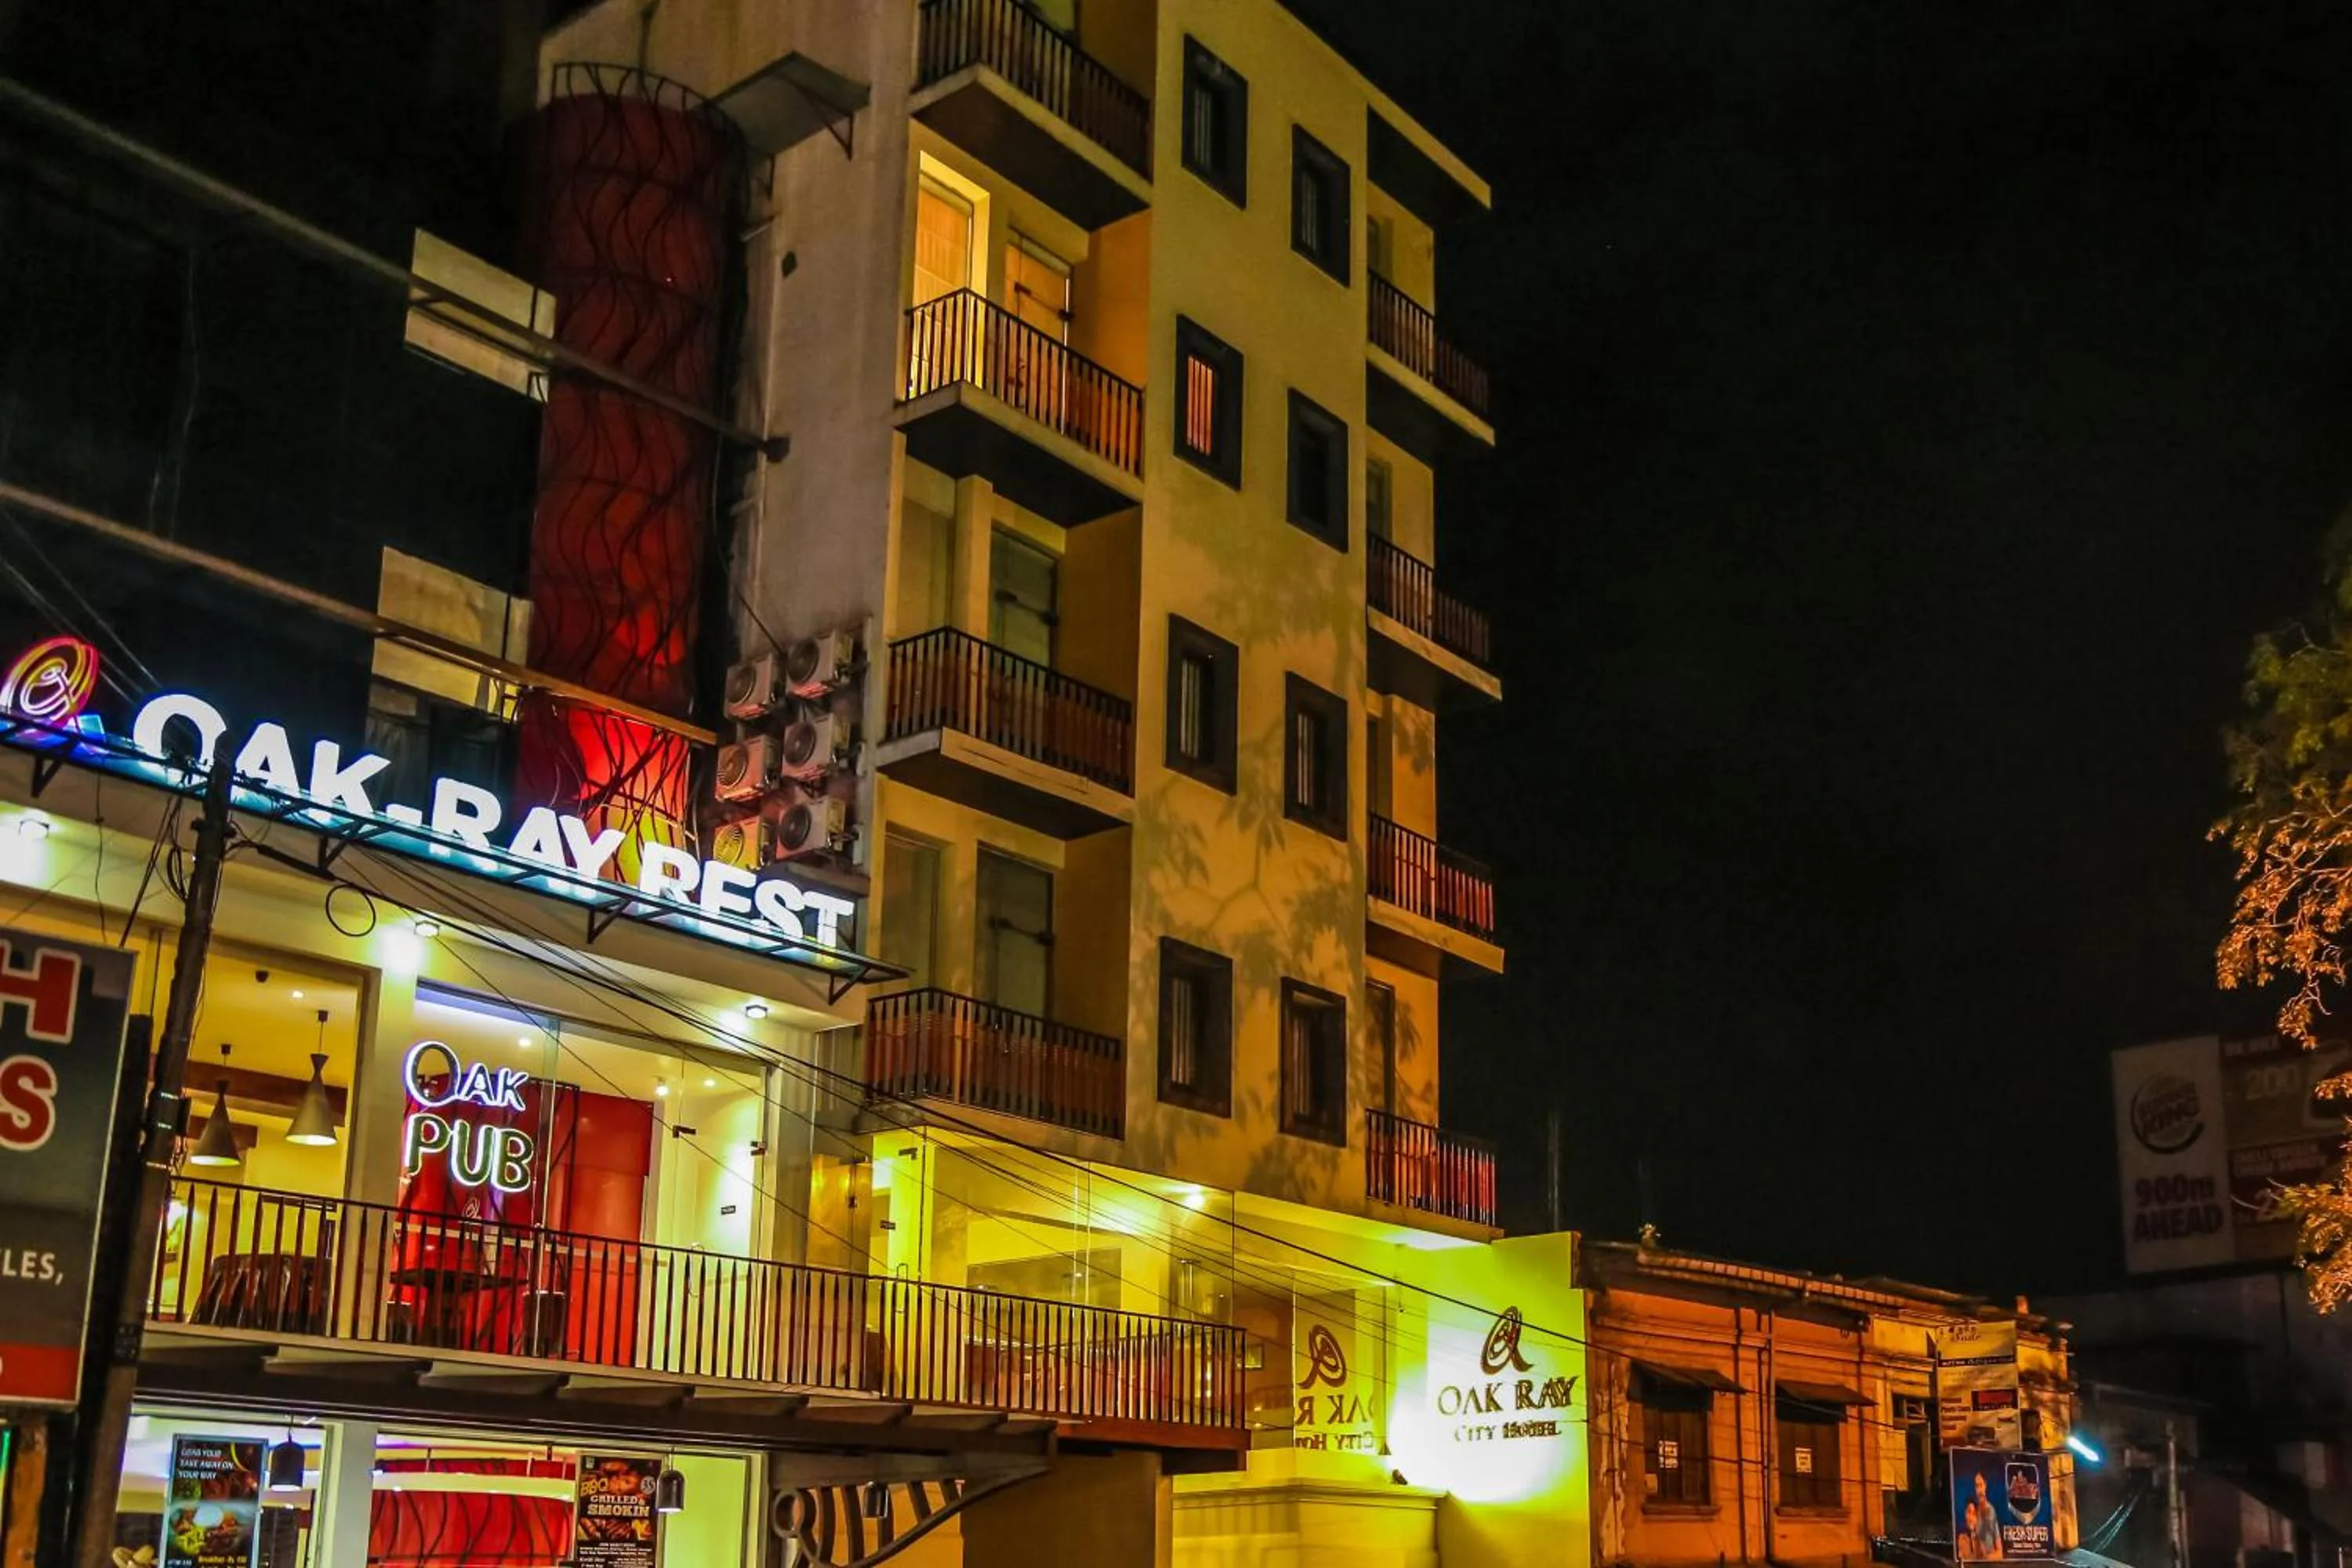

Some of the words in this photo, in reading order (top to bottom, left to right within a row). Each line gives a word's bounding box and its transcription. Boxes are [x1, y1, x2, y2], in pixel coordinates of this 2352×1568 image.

[133, 693, 626, 895] OAK-RAY
[637, 842, 855, 949] REST
[403, 1112, 534, 1192] PUB
[2133, 1204, 2223, 1243] AHEAD
[0, 1248, 64, 1286] LES,
[1438, 1382, 1504, 1416] OAK
[1514, 1375, 1581, 1410] RAY
[580, 1477, 609, 1497] BBQ
[587, 1504, 650, 1517] SMOKIN
